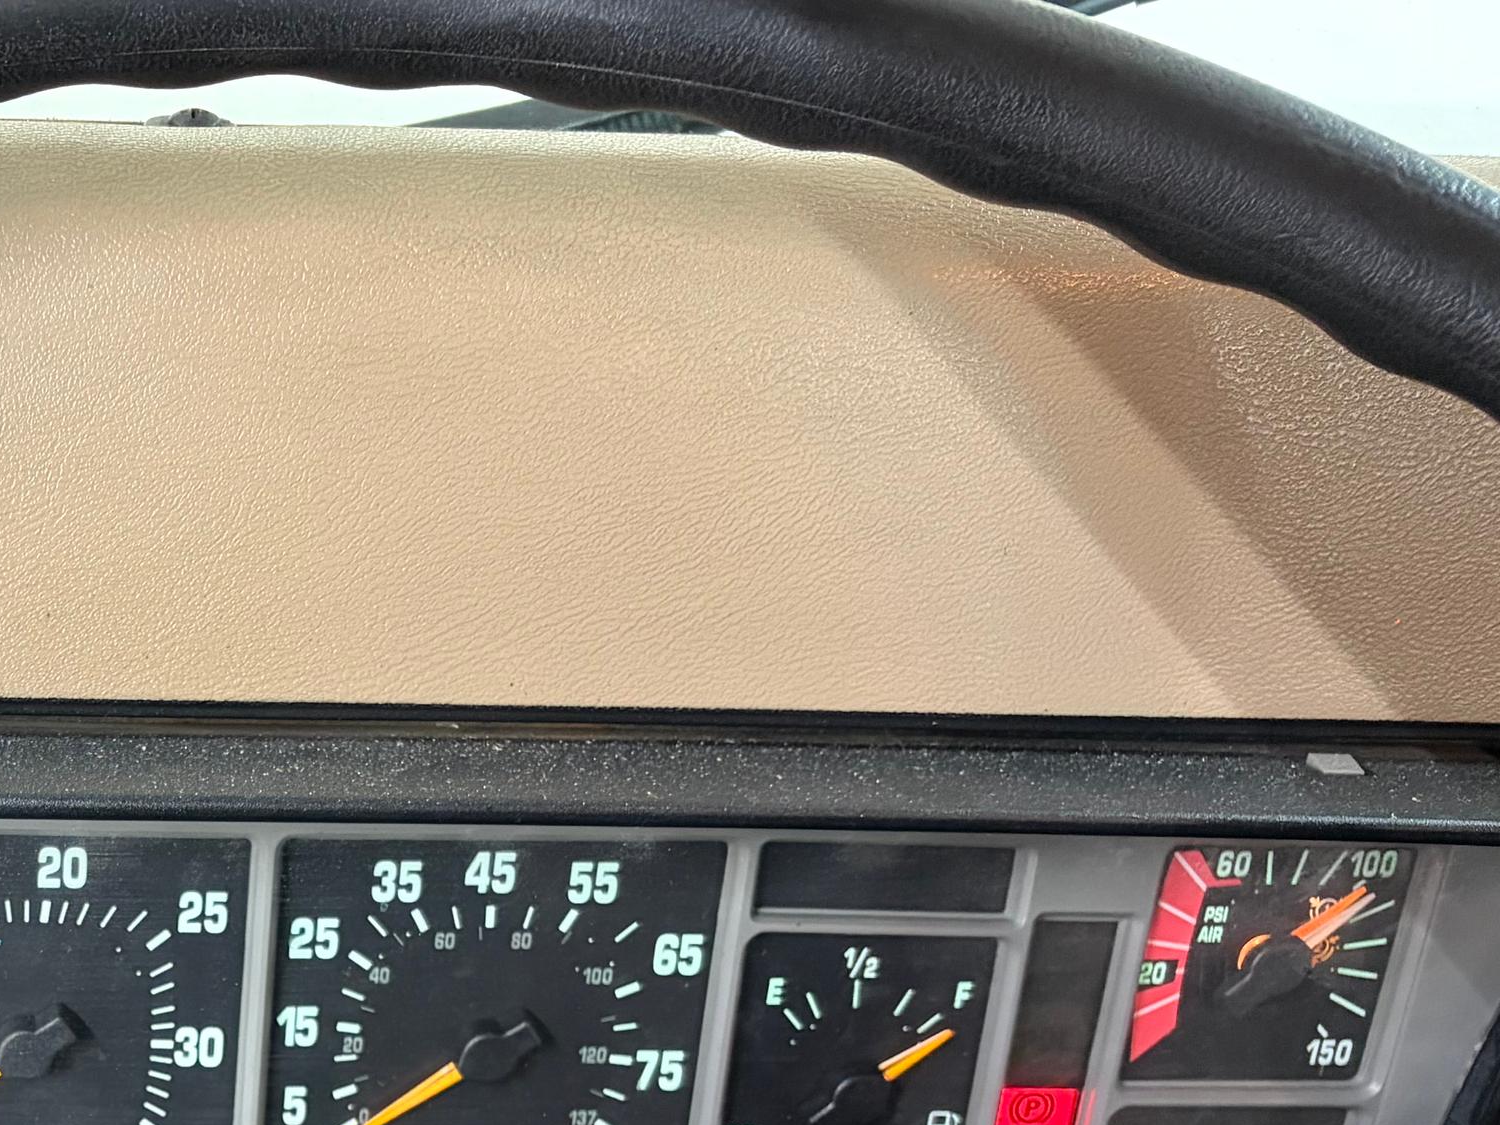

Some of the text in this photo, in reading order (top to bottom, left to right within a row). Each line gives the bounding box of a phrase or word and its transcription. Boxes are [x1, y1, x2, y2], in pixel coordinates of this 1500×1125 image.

[37, 847, 88, 889] 20
[464, 851, 517, 894] 45
[1216, 850, 1252, 878] 60
[1350, 850, 1399, 878] 100
[371, 860, 423, 903] 35
[567, 861, 620, 904] 55
[177, 891, 228, 934] 25
[1203, 906, 1228, 923] PSI
[288, 917, 339, 959] 25
[434, 933, 456, 950] 60
[510, 933, 532, 950] 80
[1197, 926, 1224, 943] AIR
[652, 933, 703, 976] 65
[369, 967, 390, 985] 40
[583, 967, 613, 985] 100
[1138, 961, 1167, 985] 20
[766, 977, 787, 1005] E
[953, 981, 975, 1009] F
[276, 1006, 319, 1047] 15
[174, 1026, 225, 1068] 30
[343, 1037, 363, 1053] 20
[579, 1047, 607, 1064] 120
[1306, 1038, 1353, 1066] 150
[635, 1050, 685, 1091] 75
[282, 1086, 307, 1125] 5
